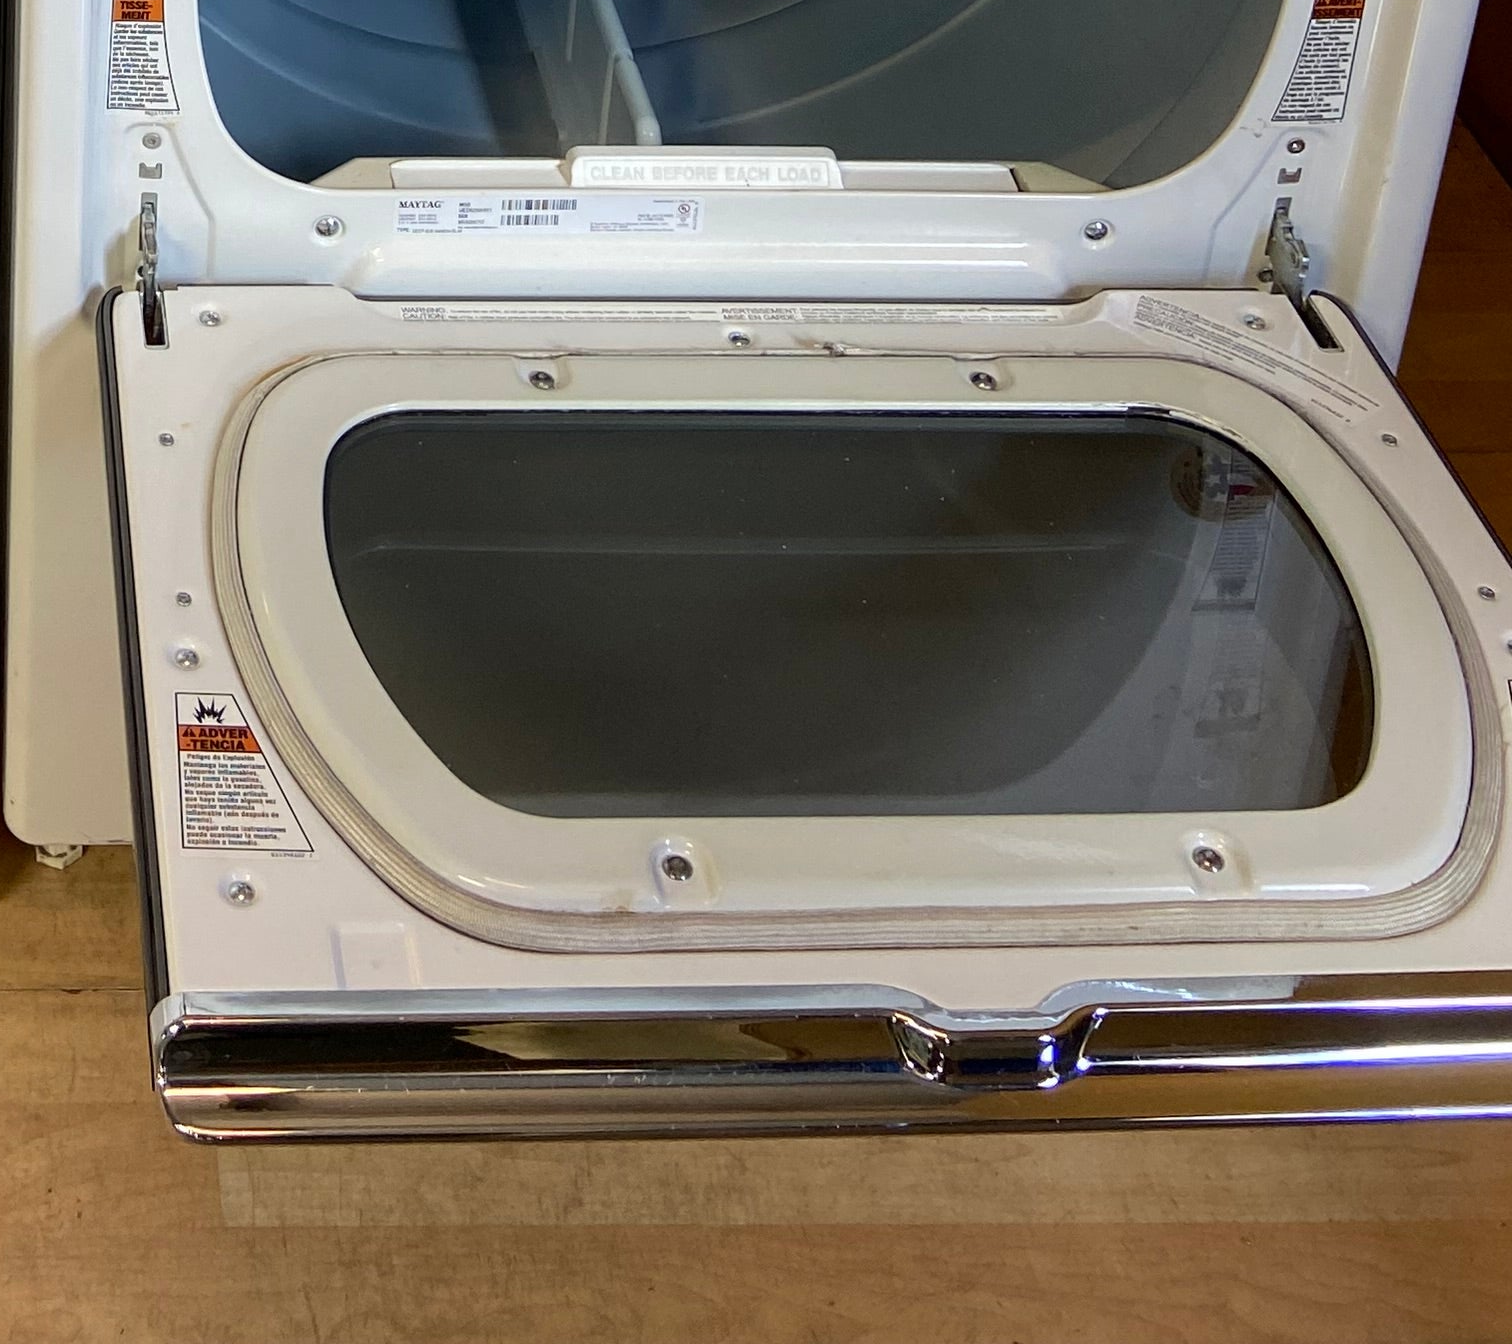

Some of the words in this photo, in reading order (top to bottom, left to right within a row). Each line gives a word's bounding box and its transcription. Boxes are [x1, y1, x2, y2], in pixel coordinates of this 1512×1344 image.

[120, 0, 153, 10] TISSE-
[121, 11, 151, 20] MENT
[590, 166, 644, 180] CLEAN
[652, 166, 718, 181] BEFORE
[726, 167, 770, 182] EACH
[778, 168, 822, 183] LOAD
[398, 200, 442, 209] MAYTAG
[198, 728, 249, 739] ADVER
[186, 740, 246, 751] -TENCIA
